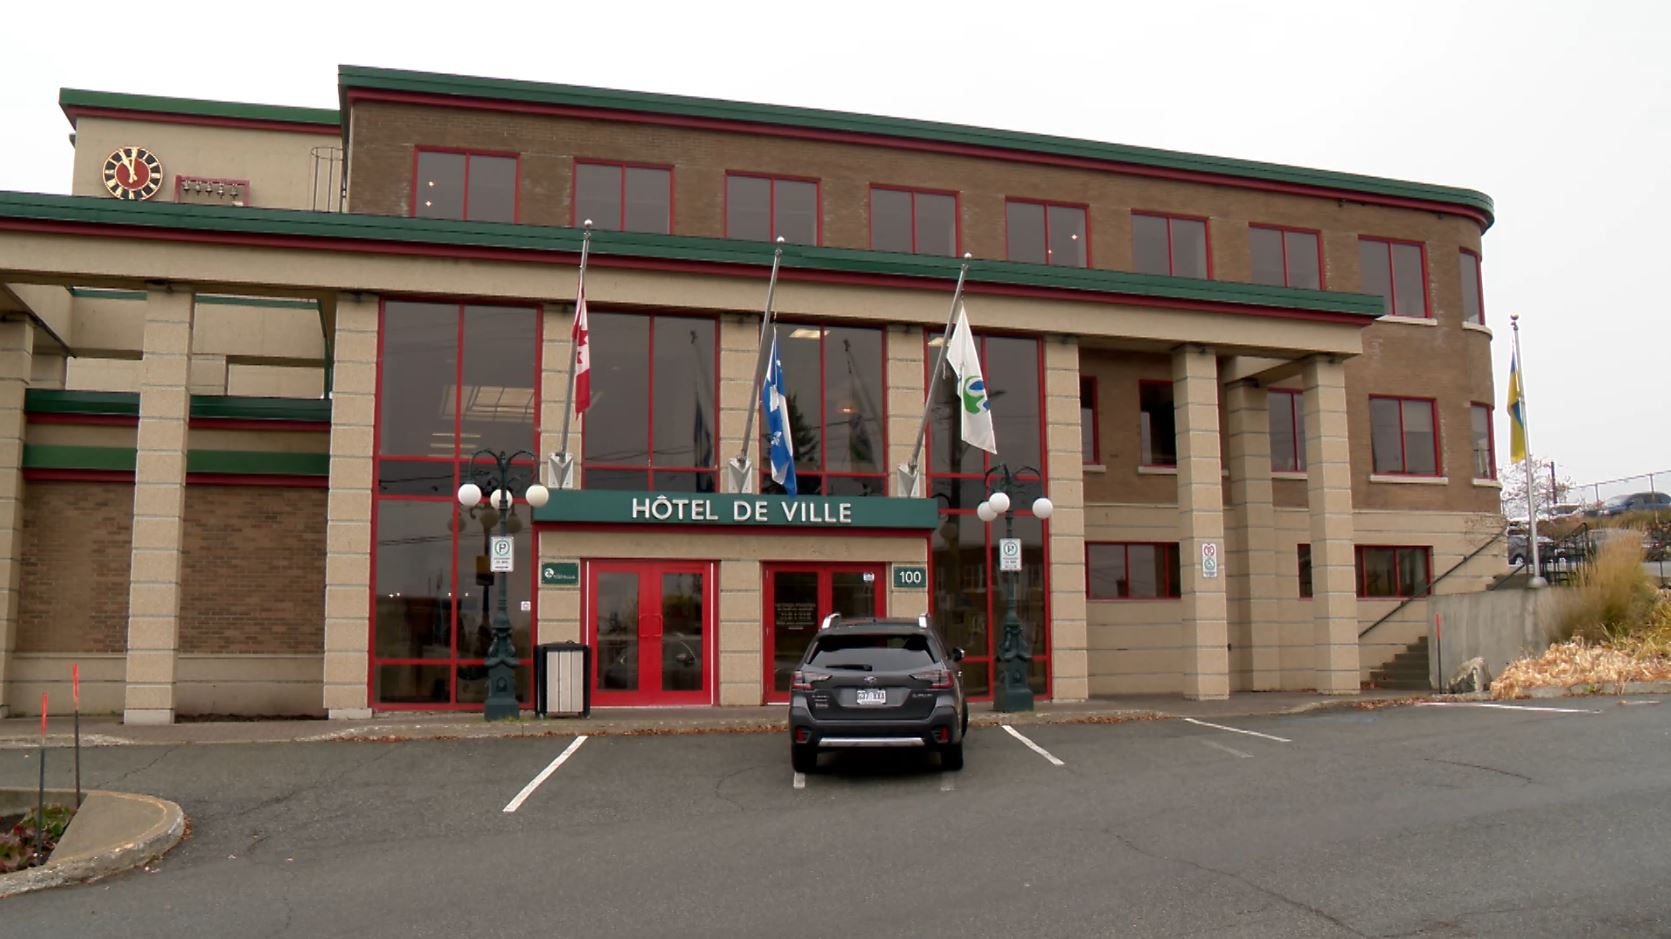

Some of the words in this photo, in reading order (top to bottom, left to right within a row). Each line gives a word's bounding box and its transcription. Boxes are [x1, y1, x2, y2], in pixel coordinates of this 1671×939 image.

[631, 494, 718, 521] HÔTEL
[733, 500, 768, 522] DE
[782, 501, 852, 524] VILLE
[899, 571, 922, 583] 100
